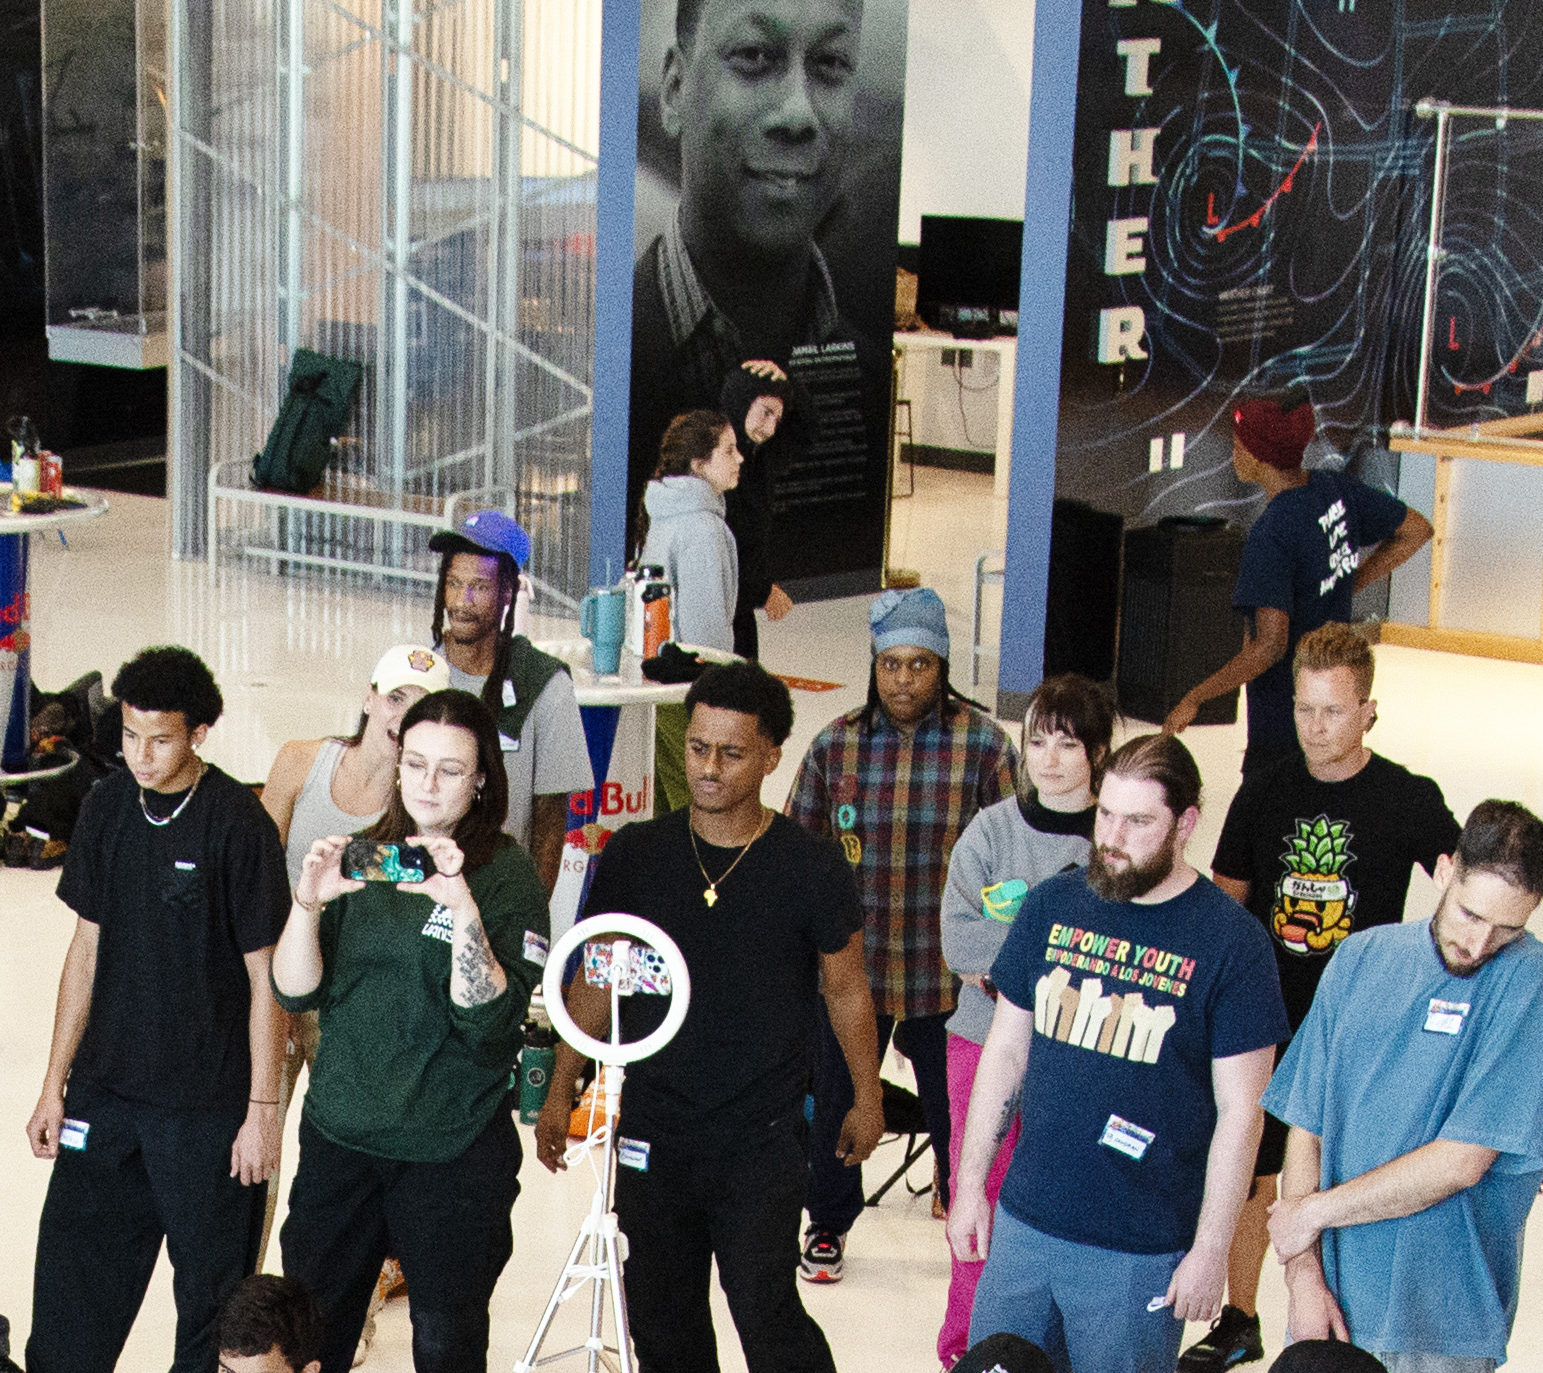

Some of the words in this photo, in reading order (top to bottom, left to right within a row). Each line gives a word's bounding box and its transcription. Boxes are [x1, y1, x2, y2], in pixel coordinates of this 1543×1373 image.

[1097, 0, 1164, 366] THER
[1045, 947, 1111, 976] EMPODERANDO
[1110, 964, 1119, 978] A
[1118, 966, 1140, 983] LOS
[1138, 971, 1188, 998] JOVENES
[1048, 923, 1131, 963] EMPOWER
[1133, 945, 1196, 981] YOUTH
